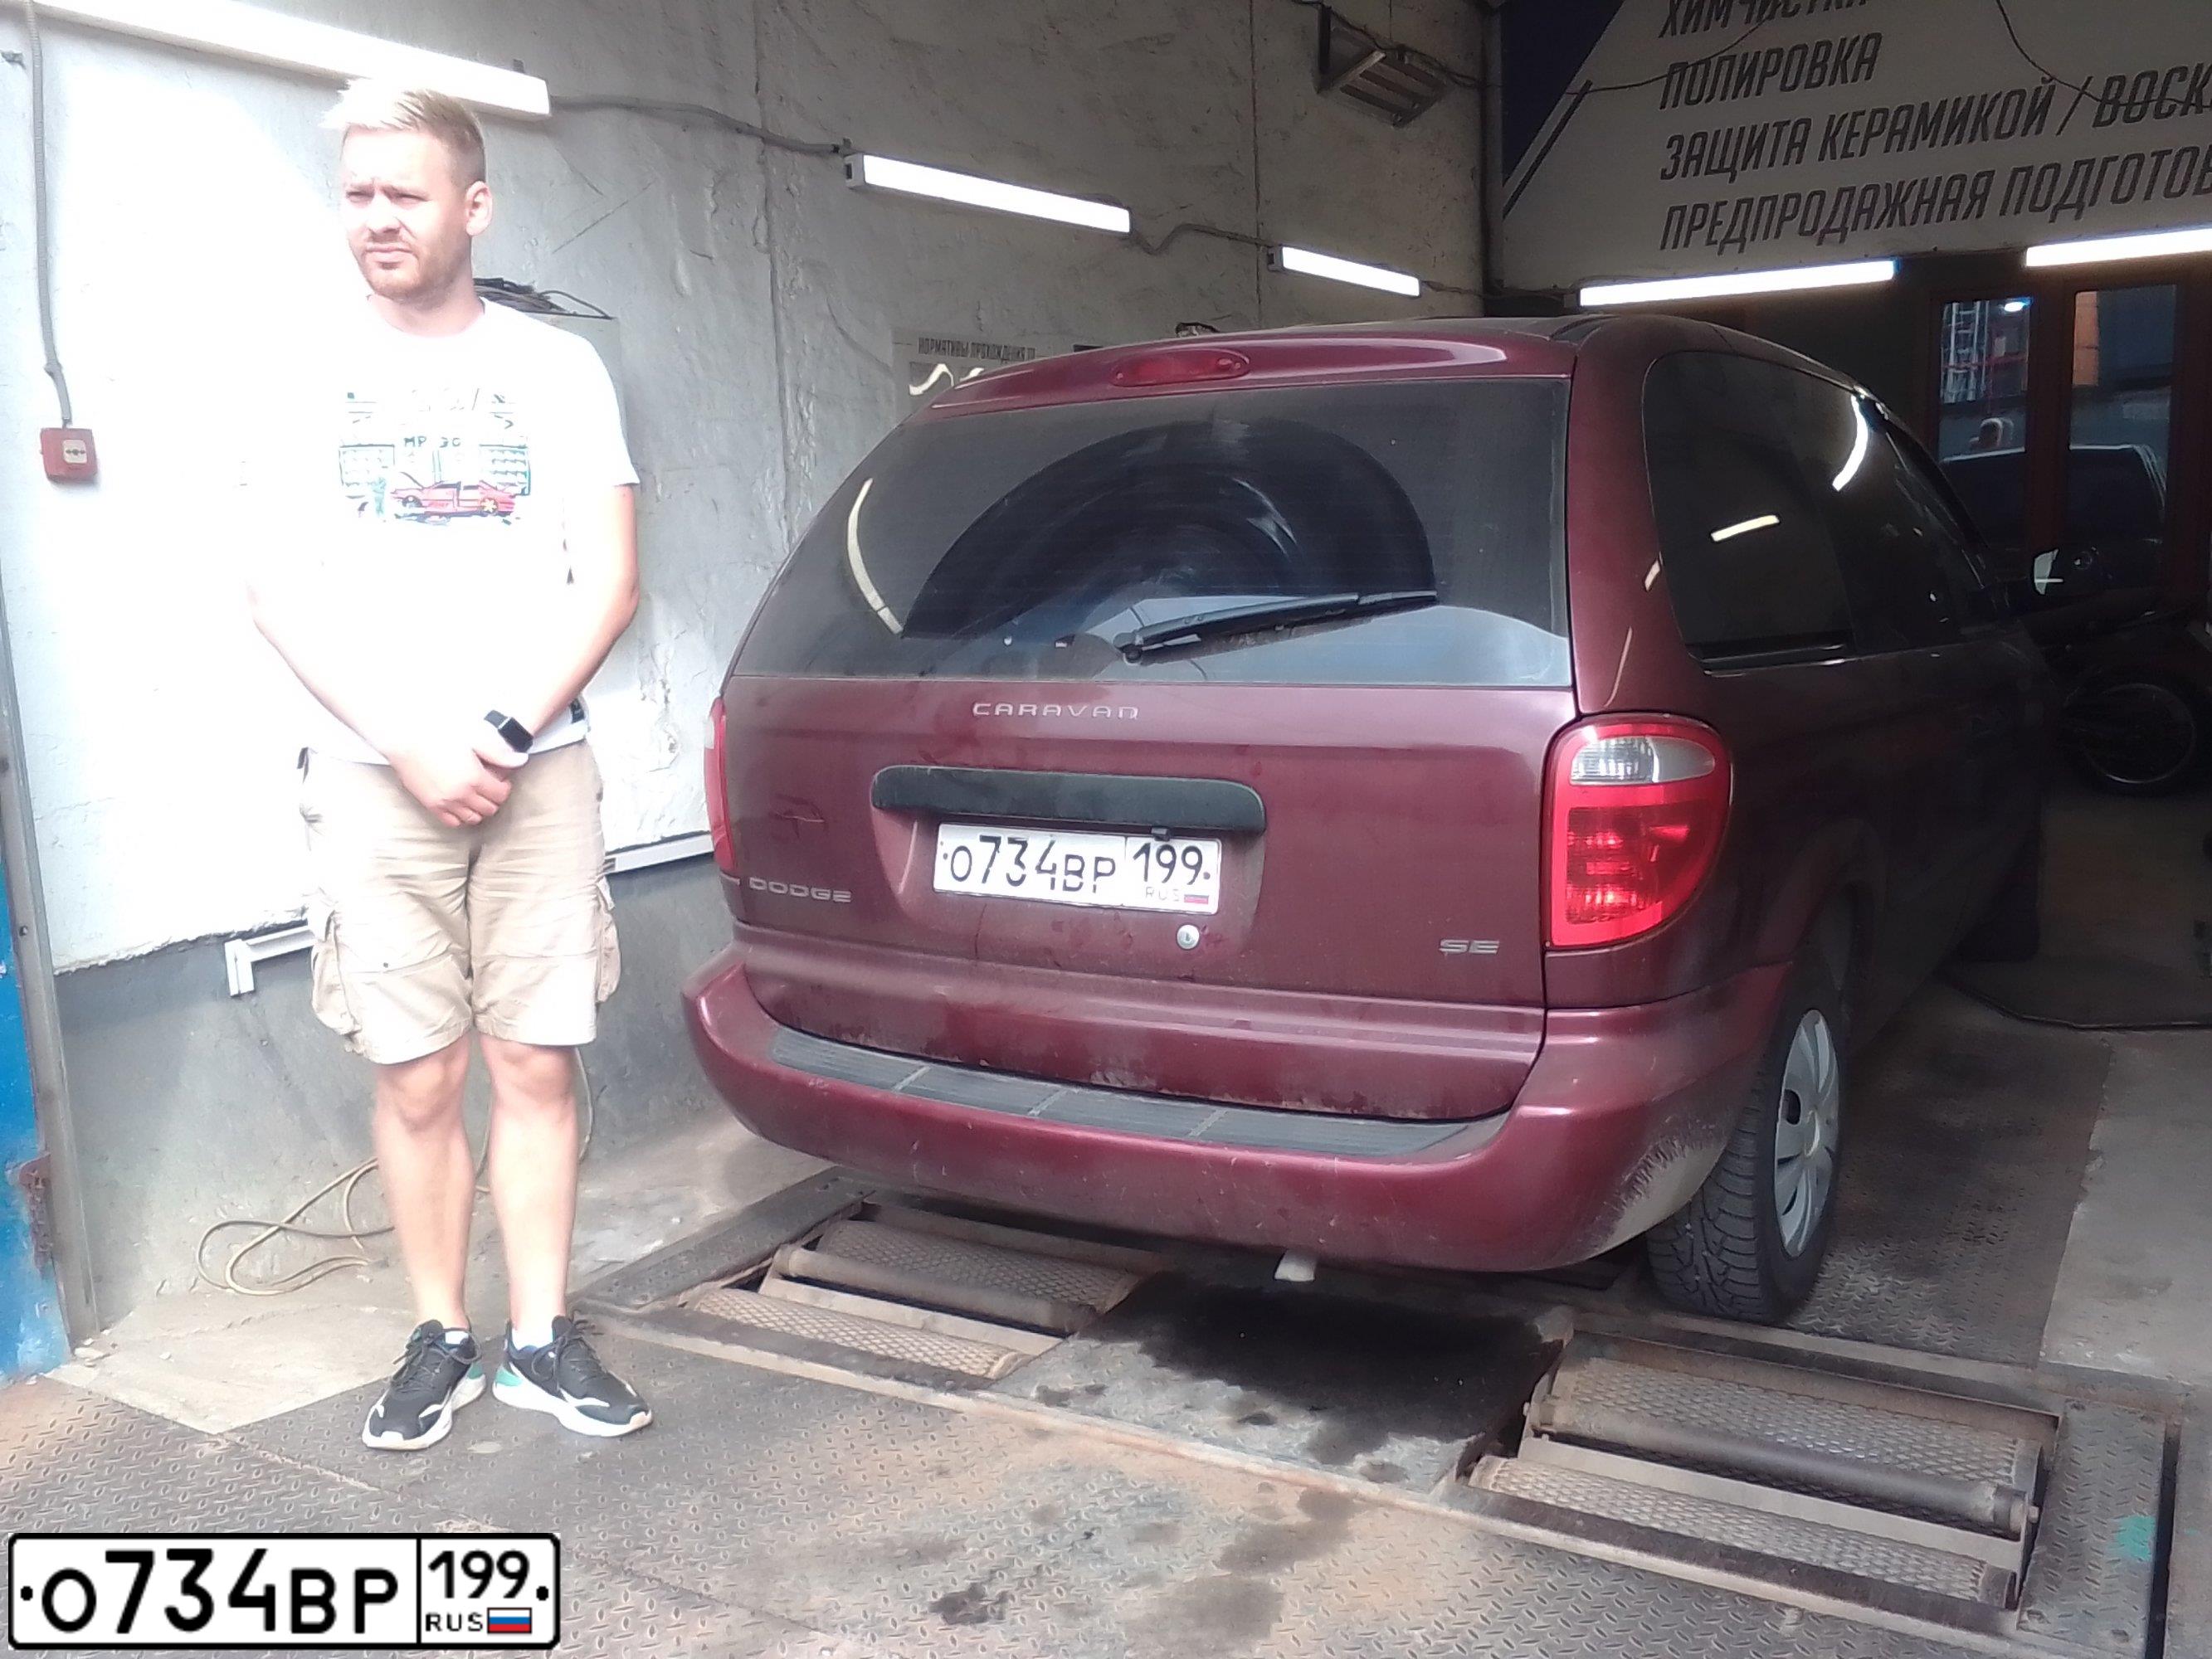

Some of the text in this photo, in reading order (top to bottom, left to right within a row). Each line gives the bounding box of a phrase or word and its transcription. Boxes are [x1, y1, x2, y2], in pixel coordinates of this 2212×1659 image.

[1659, 32, 1882, 109] ПОЛИРОВКА
[1660, 118, 1813, 184] ЗАЩИТА
[1817, 76, 2056, 163] КЕРАМИКОЙ
[2092, 63, 2212, 129] ВОСК
[1659, 168, 1995, 256] ПРЕДПРОДАЖНАЯ
[972, 703, 1139, 720] CARAVAN
[1133, 842, 1203, 885] 199
[748, 877, 852, 902] DODGE
[1145, 886, 1180, 902] RUS
[1438, 939, 1500, 955] SE
